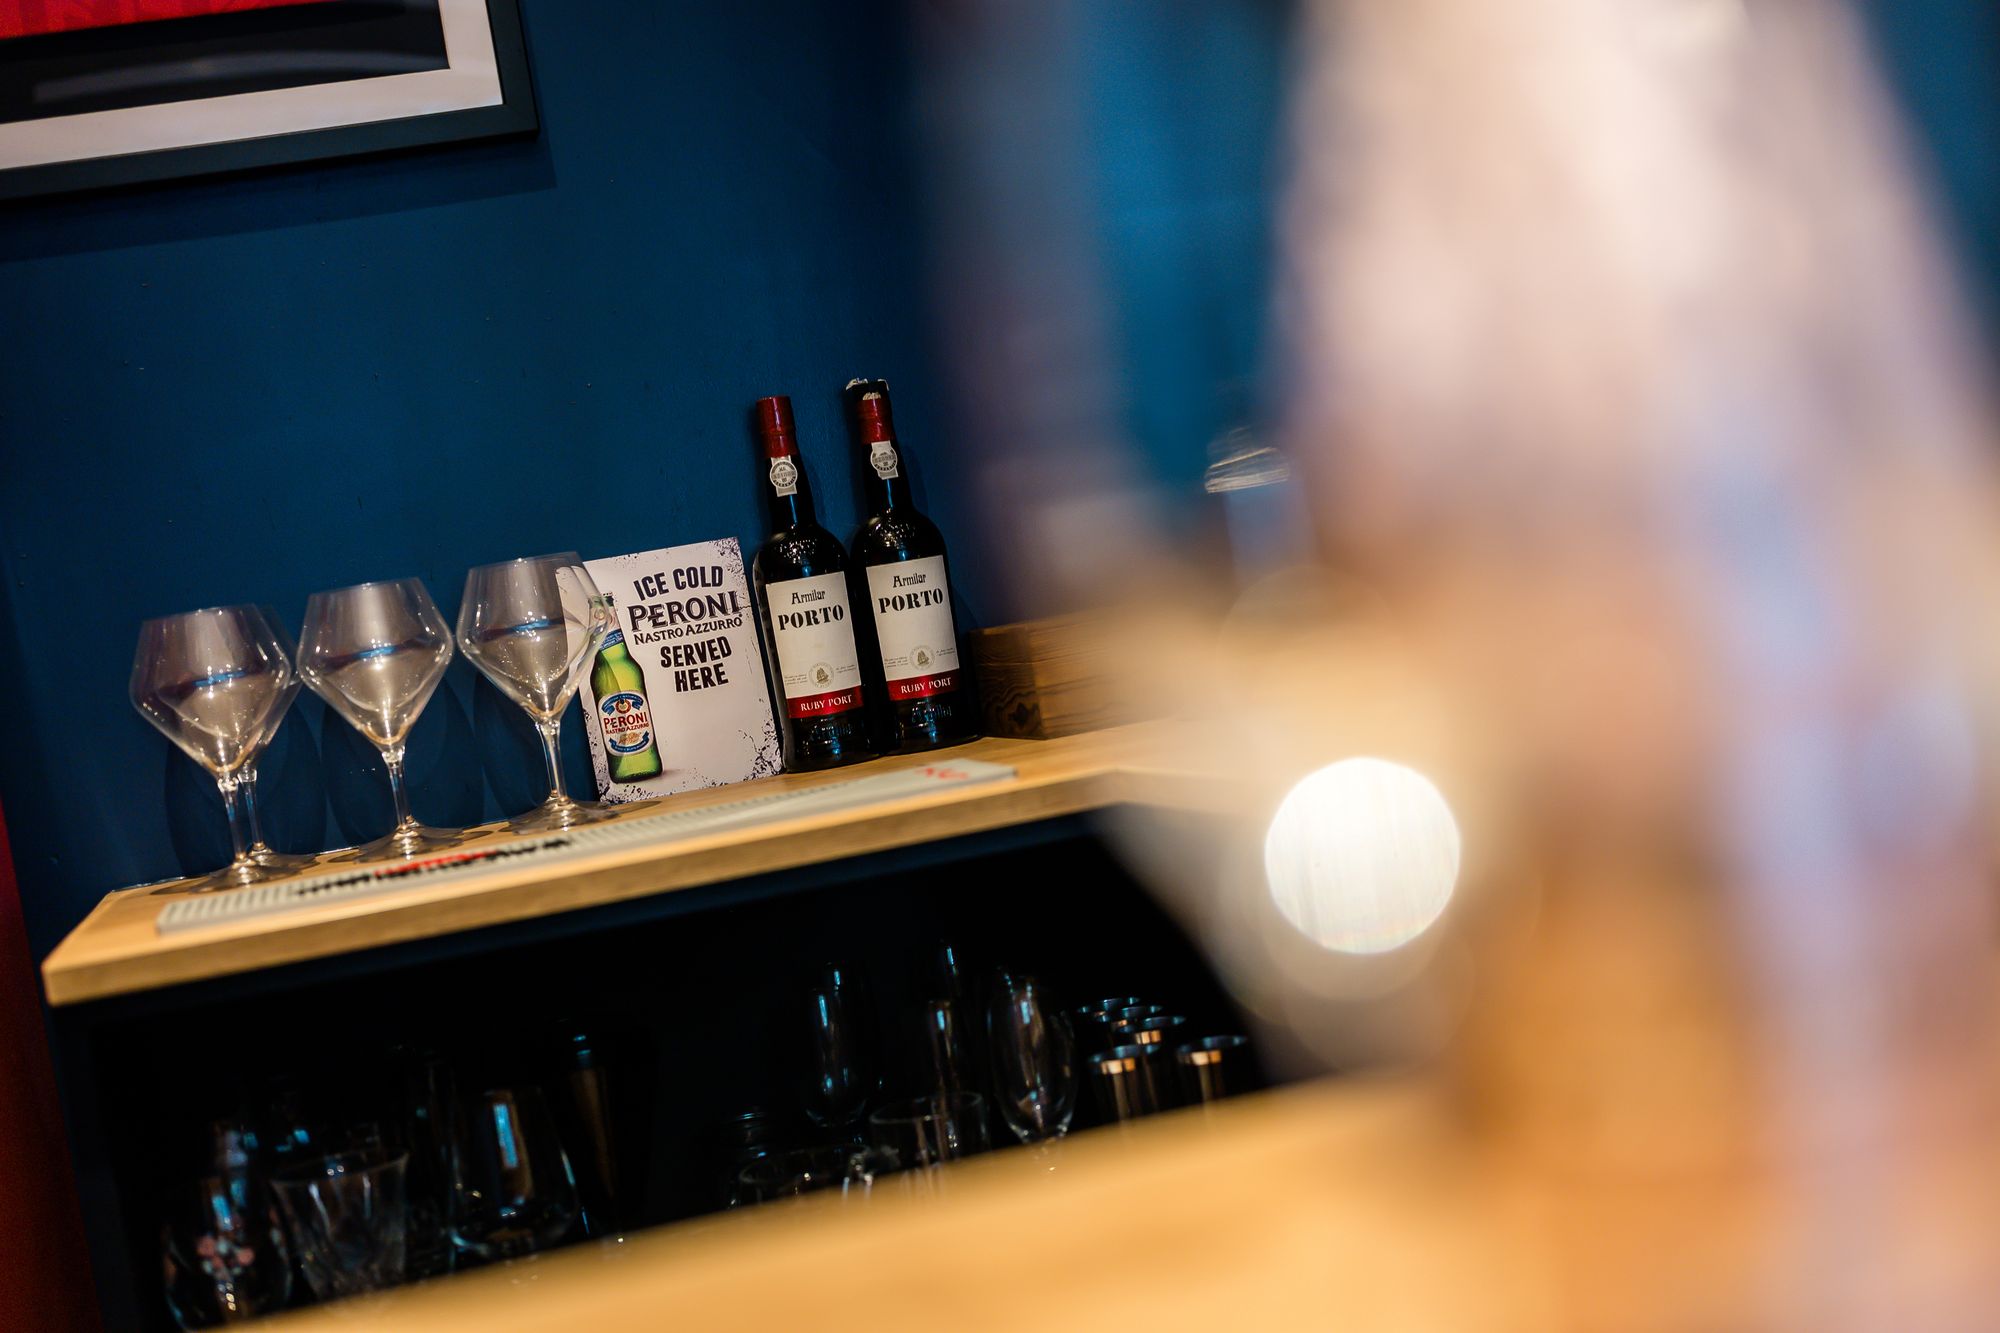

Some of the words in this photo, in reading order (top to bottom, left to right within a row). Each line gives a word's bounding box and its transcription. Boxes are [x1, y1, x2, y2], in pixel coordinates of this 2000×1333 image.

[633, 573, 670, 601] ICE
[673, 565, 723, 591] COLD
[892, 572, 927, 589] Armilar
[791, 588, 826, 605] Armilar
[878, 587, 944, 614] PORTO
[626, 590, 742, 632] PERONI
[777, 604, 844, 631] PORTO
[634, 627, 684, 645] NASTRO
[685, 617, 743, 637] AZZURRO
[660, 636, 732, 668] SERVED
[674, 662, 729, 693] HERE
[900, 683, 927, 694] RUBY
[928, 677, 952, 690] PORT
[800, 700, 827, 712] RUBY
[828, 694, 853, 707] PORT
[603, 711, 648, 729] PERONI
